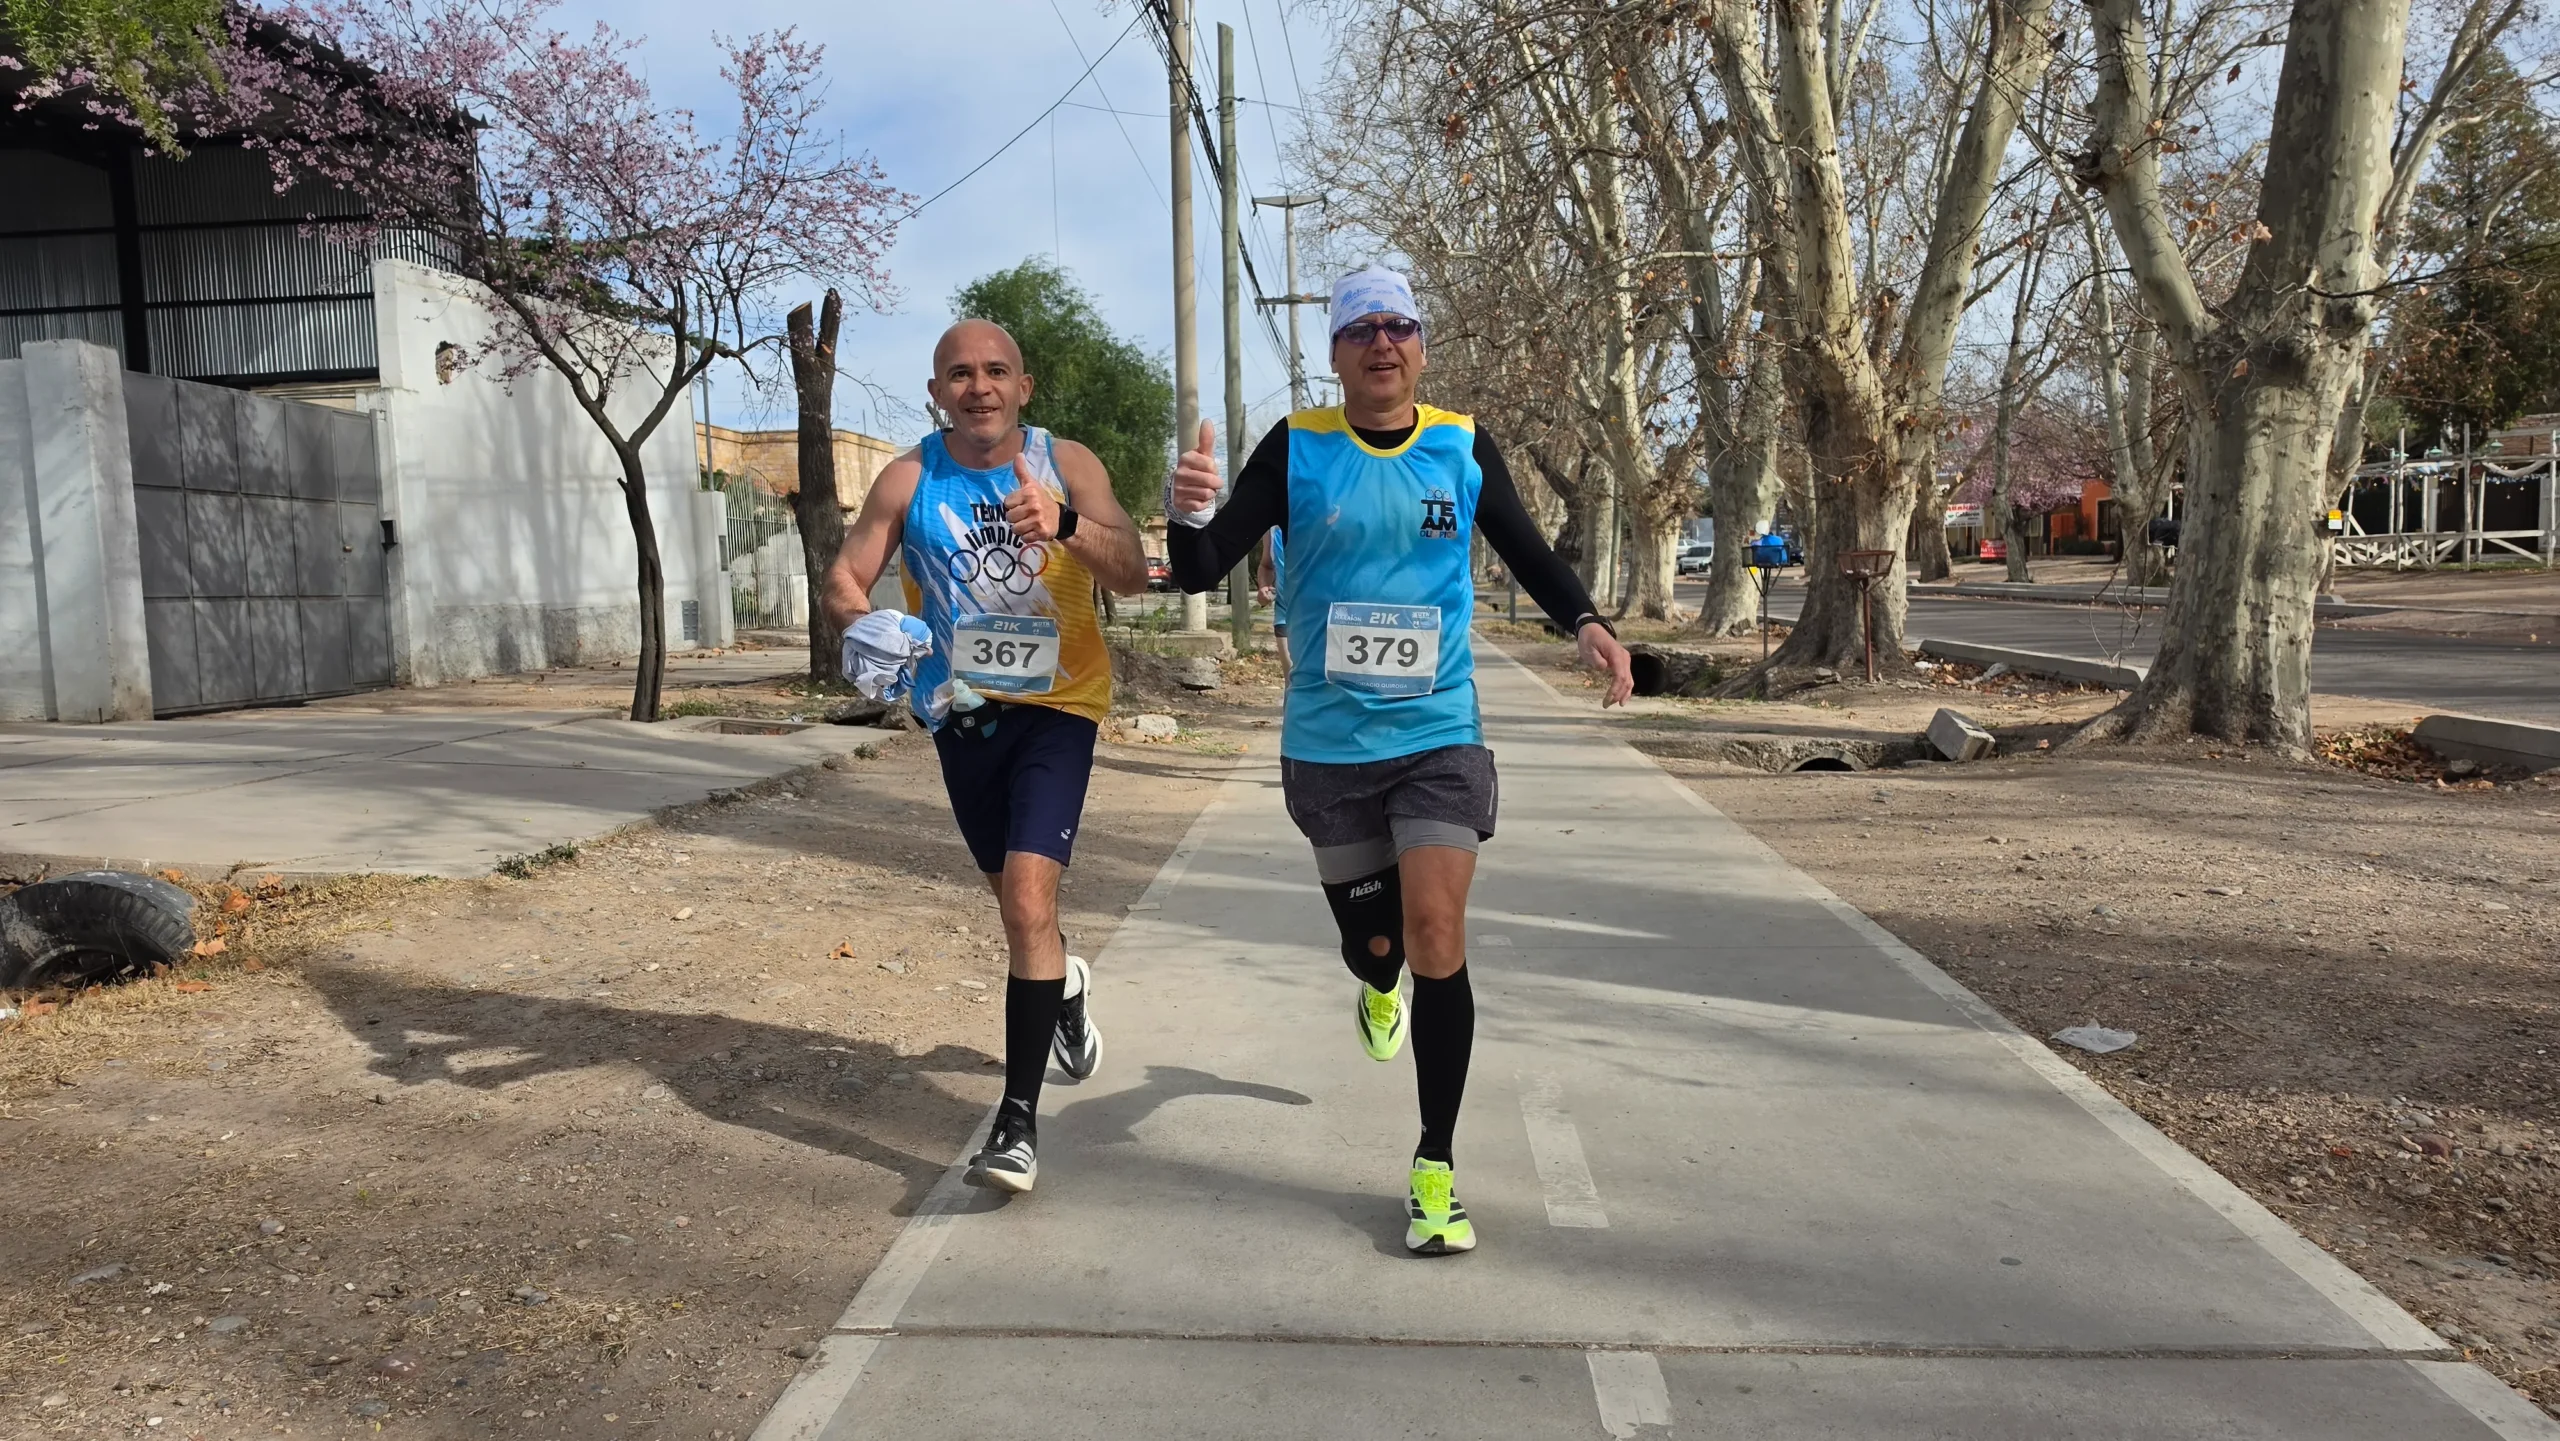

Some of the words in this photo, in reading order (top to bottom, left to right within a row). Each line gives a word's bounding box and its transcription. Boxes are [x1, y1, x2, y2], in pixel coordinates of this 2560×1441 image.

[993, 620, 1021, 632] 21K
[1369, 611, 1400, 625] 21K
[972, 638, 1040, 669] 367
[1346, 634, 1419, 668] 379
